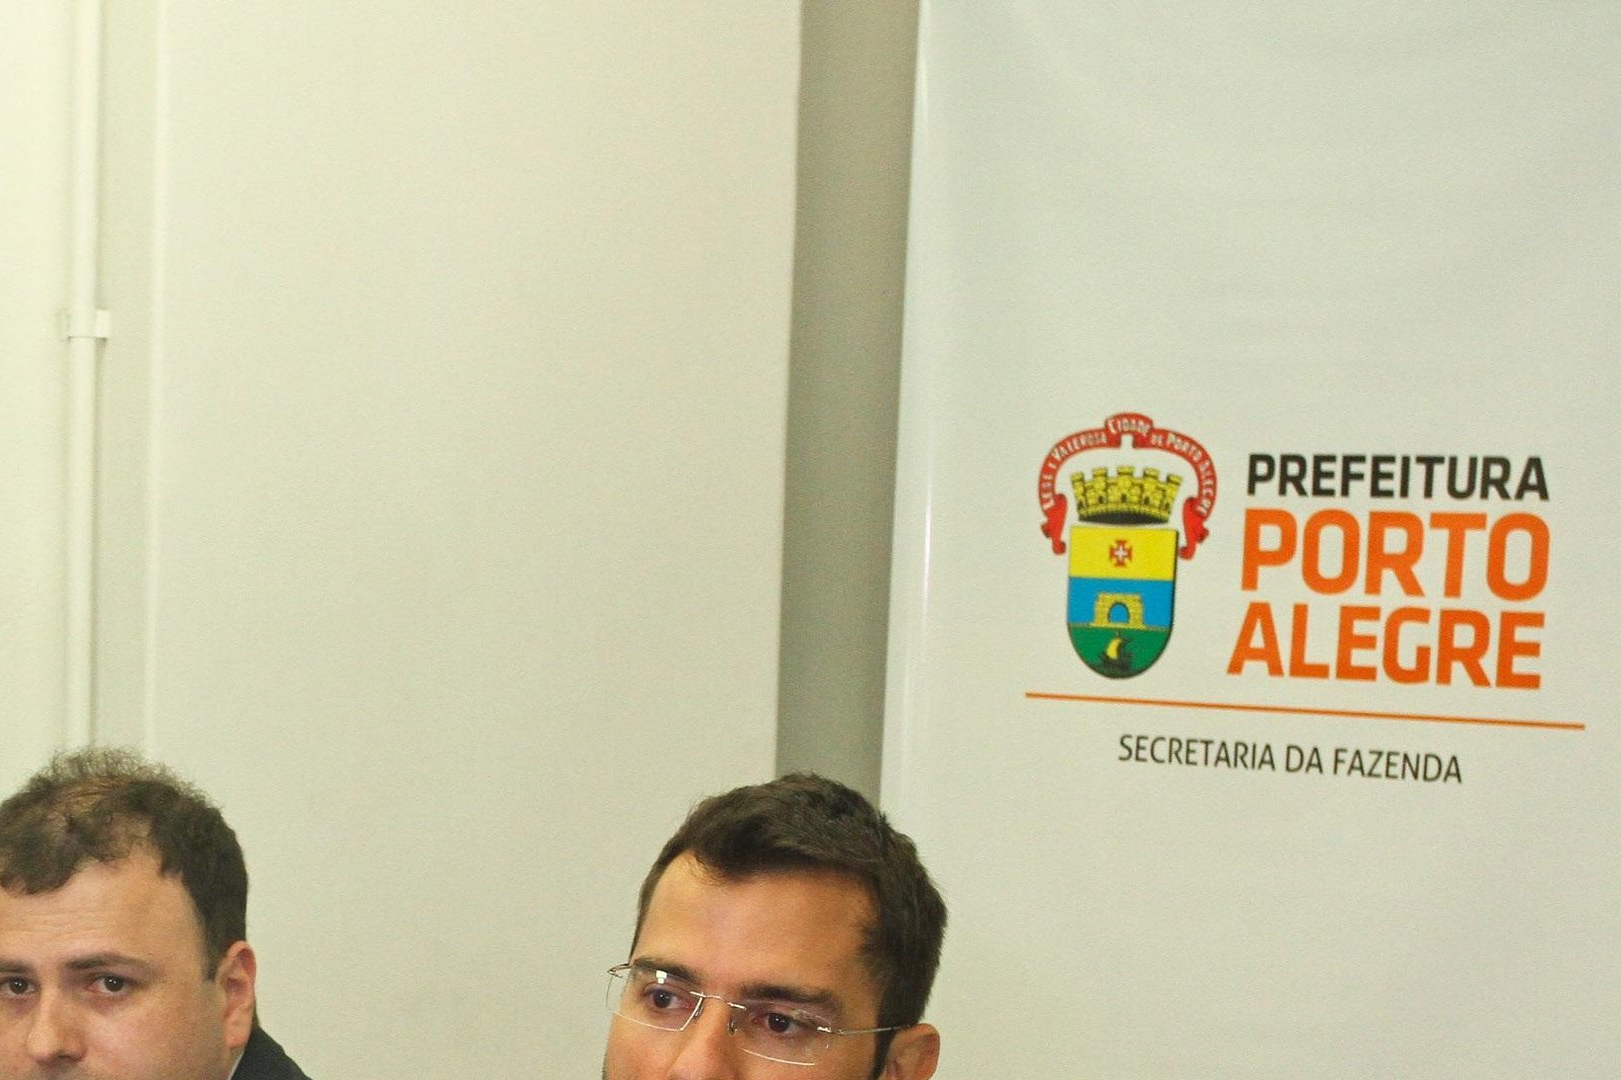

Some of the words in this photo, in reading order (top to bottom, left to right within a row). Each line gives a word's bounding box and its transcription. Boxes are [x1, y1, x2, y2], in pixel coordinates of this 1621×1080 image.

[1246, 452, 1550, 501] PREFEITURA
[1240, 507, 1551, 602] PORTO
[1226, 601, 1546, 690] ALEGRE
[1118, 733, 1276, 772] SECRETARIA
[1284, 744, 1324, 776] DA
[1332, 747, 1463, 784] FAZENDA
